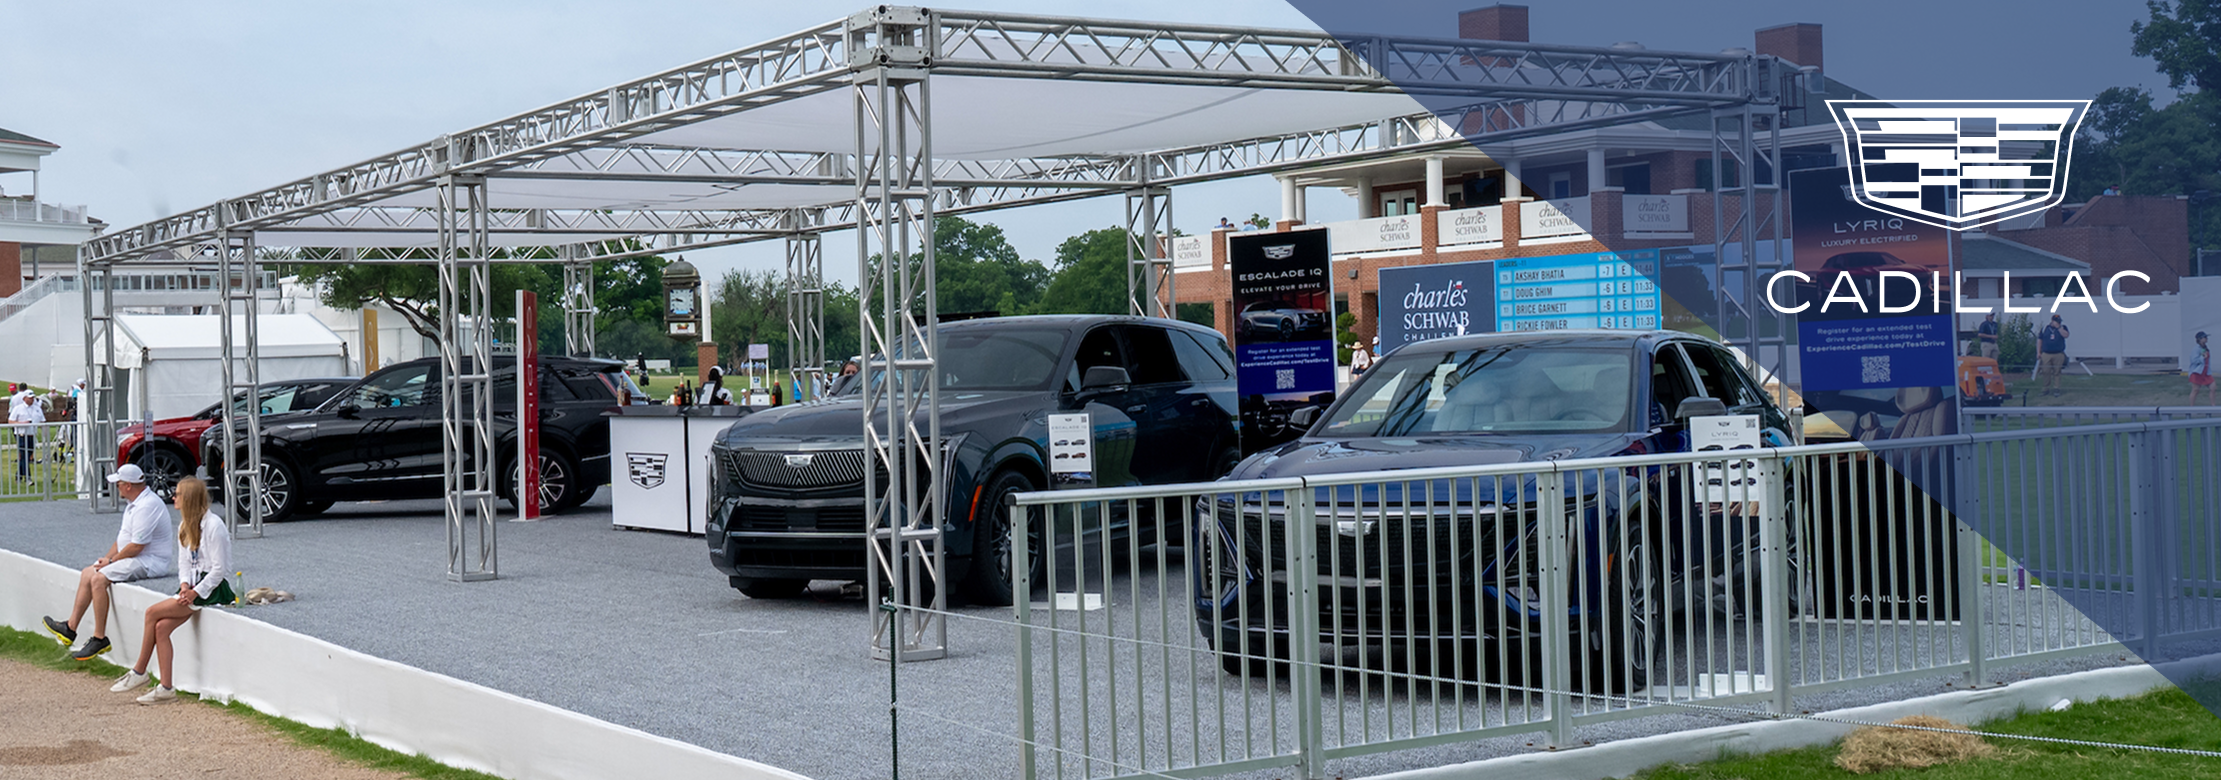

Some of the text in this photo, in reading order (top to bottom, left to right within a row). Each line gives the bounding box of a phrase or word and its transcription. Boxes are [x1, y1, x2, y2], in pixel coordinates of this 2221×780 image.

[1539, 204, 1573, 218] charles
[1638, 199, 1670, 212] charles
[1455, 212, 1486, 226] charles
[1539, 217, 1574, 228] SCHWAB
[1638, 214, 1670, 222] SCHWAB
[1380, 219, 1409, 232] charles
[1455, 226, 1487, 236] SCHWAB
[1834, 218, 1904, 234] LYRIQ
[1380, 232, 1410, 242] SCHWAB
[1821, 234, 1918, 247] LUXURY ELECTRIFIED
[1240, 269, 1305, 281] ESCALADE
[1515, 270, 1539, 281] AKSHAY
[1541, 269, 1564, 280] BHATIA
[1602, 266, 1610, 274] -7
[1621, 265, 1626, 275] E
[1241, 286, 1272, 294] ELEVATE
[1403, 280, 1468, 309] charles
[1516, 288, 1533, 298] DOUG
[1536, 287, 1553, 297] GHIM
[1603, 283, 1611, 293] -6
[1622, 283, 1627, 293] E
[1635, 281, 1653, 291] 11:33
[1516, 304, 1536, 314] BRICE
[1538, 303, 1567, 313] GARNETT
[1603, 301, 1611, 310] -6
[1623, 300, 1627, 310] E
[1636, 299, 1653, 309] 11:33
[1404, 310, 1470, 330] SCHWAB
[1516, 322, 1538, 330] RICKIE
[1541, 320, 1568, 330] FOWLER
[1604, 318, 1611, 328] -6
[1623, 317, 1627, 327] E
[1636, 317, 1654, 326] 11:33
[1817, 327, 1849, 335] Register
[1847, 334, 1889, 343] experience
[1891, 333, 1913, 341] today
[1806, 340, 1945, 353] ExperienceCadillac.com/TestDrive
